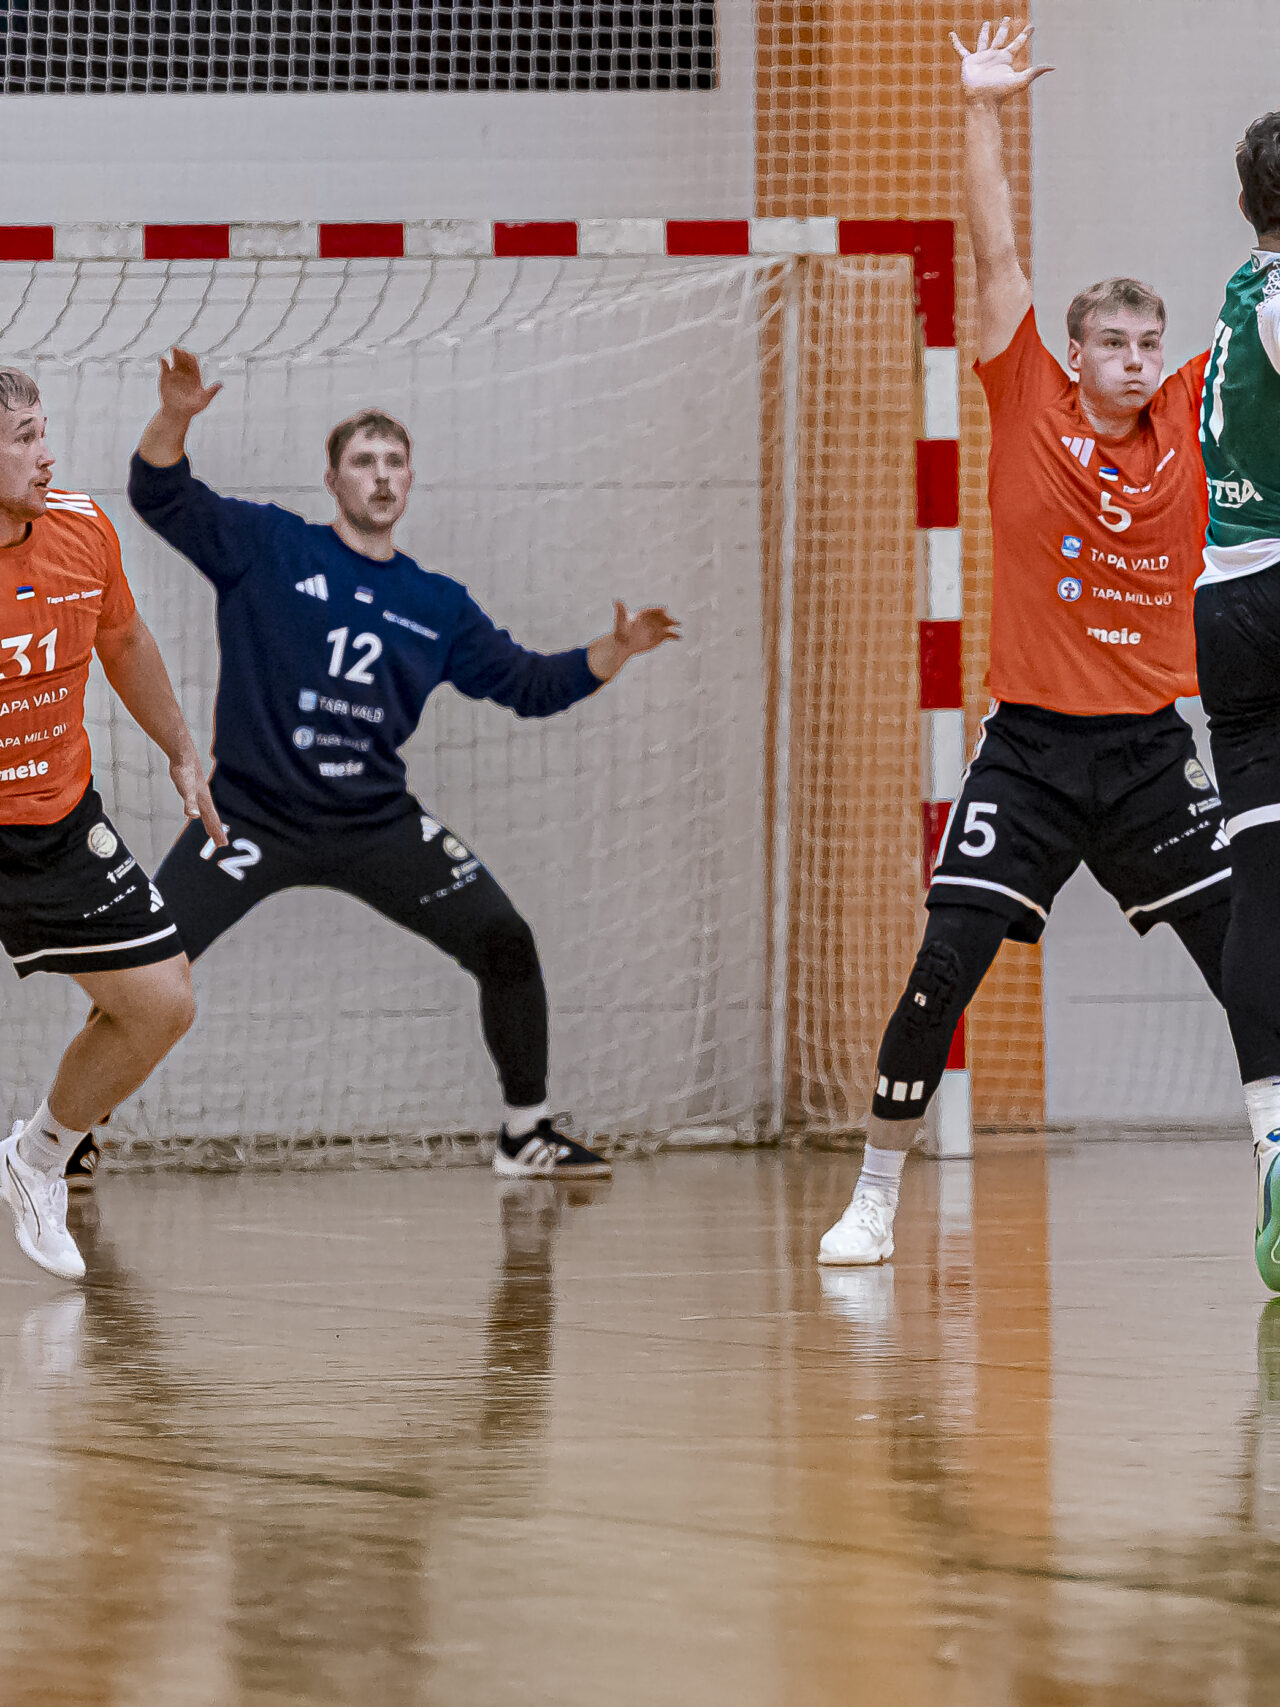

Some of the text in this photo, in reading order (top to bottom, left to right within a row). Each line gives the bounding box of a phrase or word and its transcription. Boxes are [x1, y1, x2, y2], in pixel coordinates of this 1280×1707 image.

[1090, 547, 1169, 571] TAPA VALD
[1092, 587, 1122, 601] TAPA
[1125, 591, 1153, 606] MILL
[0, 627, 58, 680] 31
[326, 626, 383, 685] 12
[0, 687, 69, 717] APA VALD
[24, 729, 50, 745] MILL
[958, 801, 998, 858] 5
